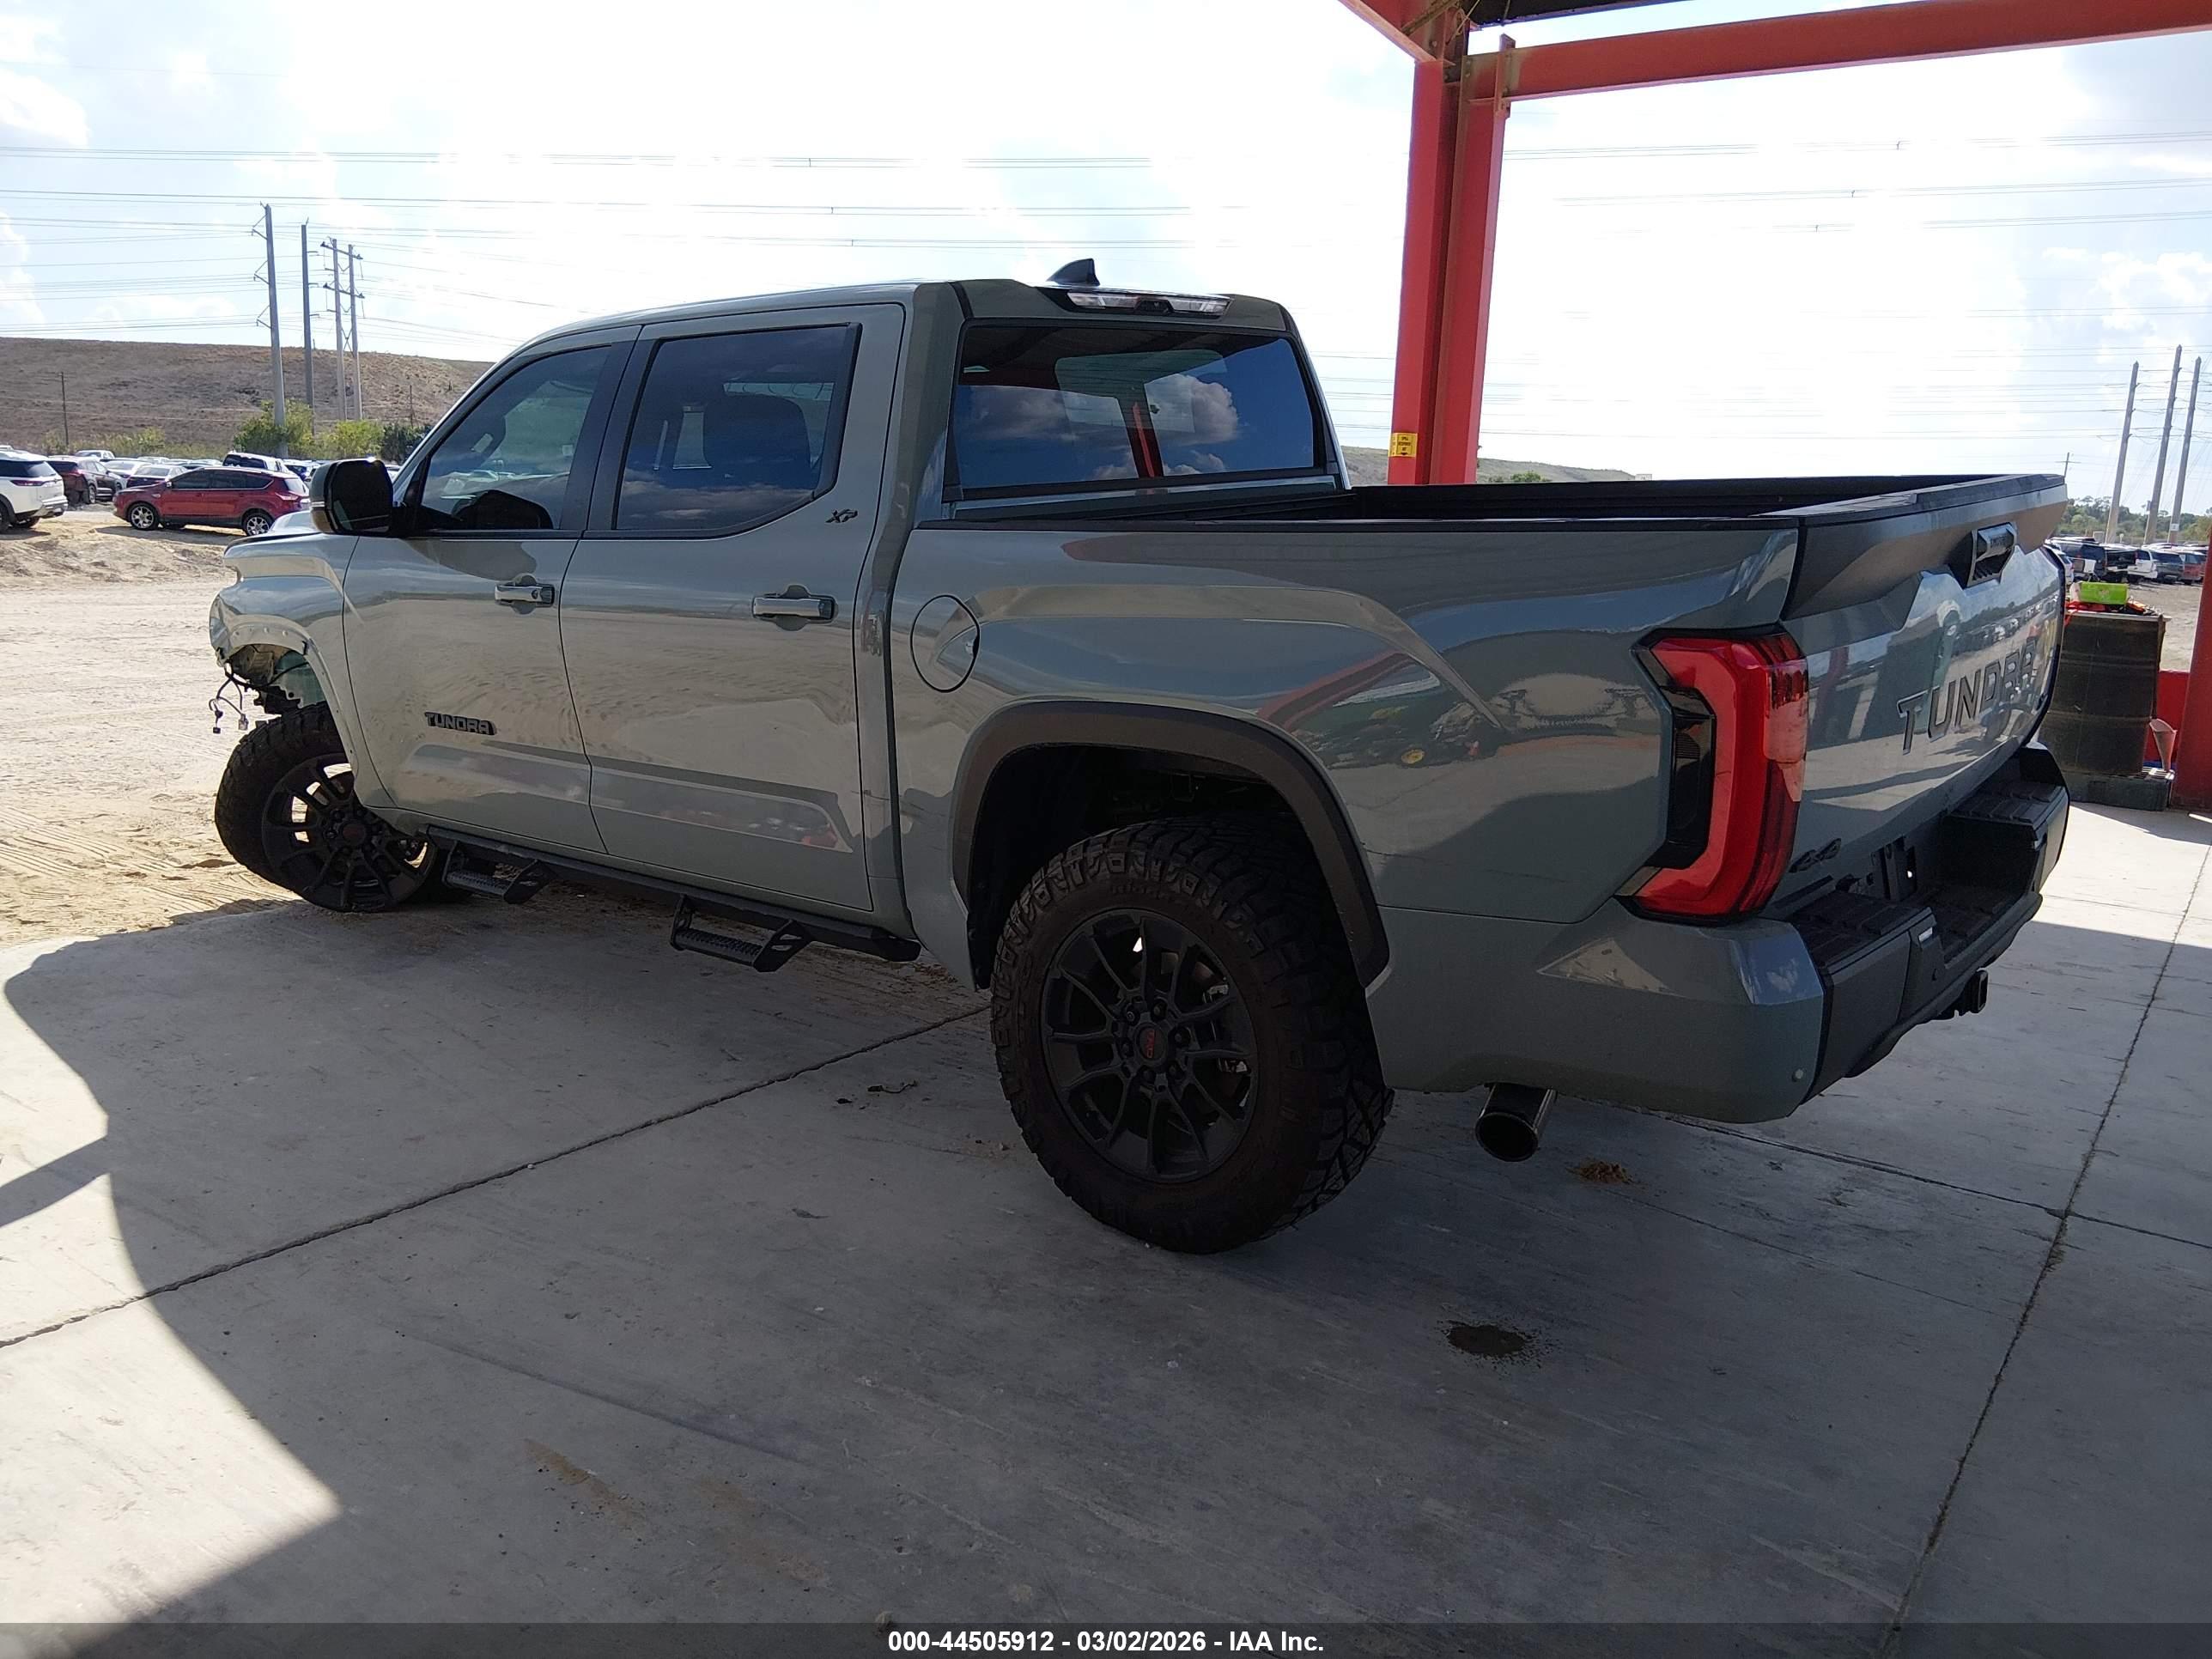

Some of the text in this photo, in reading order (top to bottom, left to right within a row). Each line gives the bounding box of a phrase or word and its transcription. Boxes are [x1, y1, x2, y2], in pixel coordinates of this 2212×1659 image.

[825, 508, 859, 523] XP
[1897, 636, 2037, 754] TUNDRA
[424, 711, 496, 736] TUNDRA
